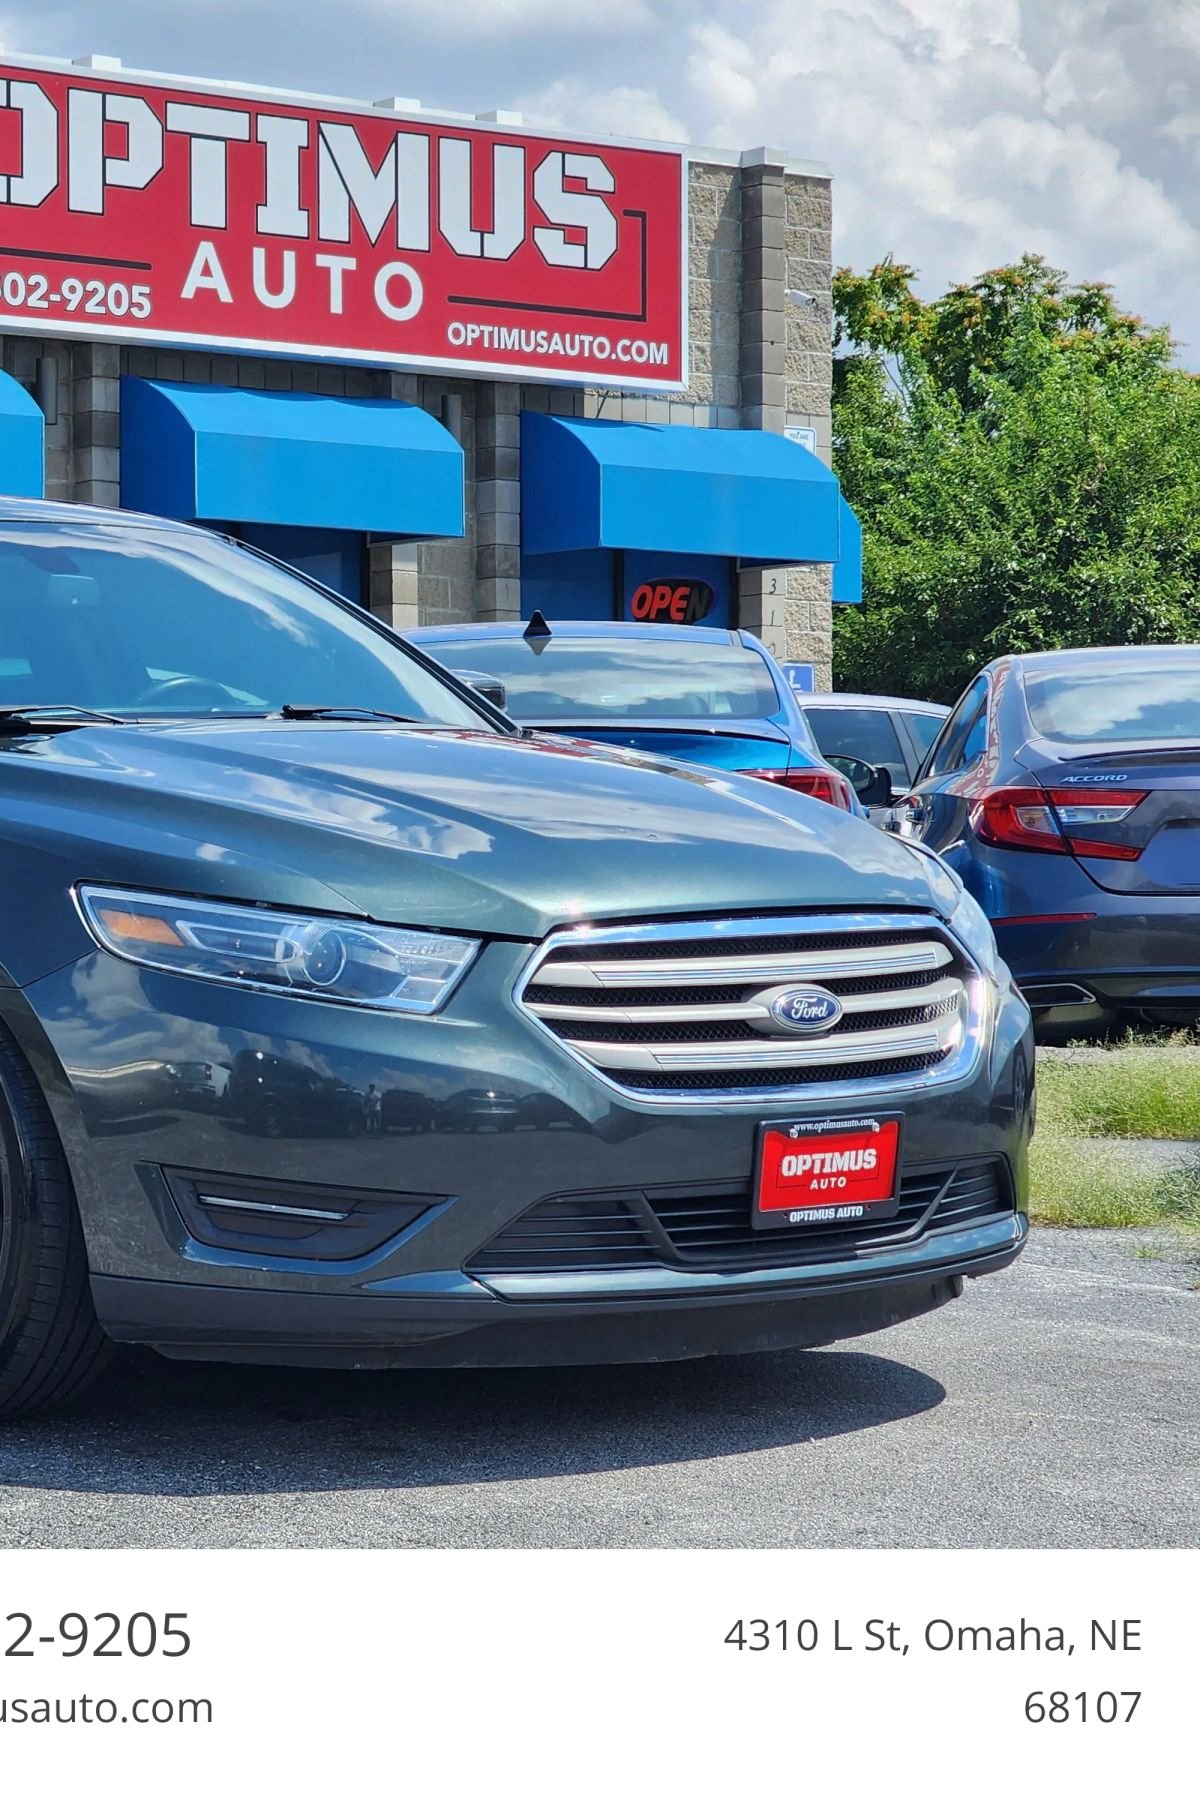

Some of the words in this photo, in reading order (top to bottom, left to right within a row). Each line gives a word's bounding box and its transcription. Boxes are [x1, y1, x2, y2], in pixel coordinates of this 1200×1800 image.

[180, 241, 425, 322] AUTO
[446, 321, 669, 366] OPTIMUSAUTO.COM
[631, 584, 709, 621] OPEN
[1060, 774, 1128, 783] ACCORD
[791, 997, 828, 1020] Ford
[793, 1117, 876, 1134] www.optimusauto.com
[781, 1148, 877, 1178] OPTIMUS
[810, 1176, 847, 1190] AUTO
[789, 1207, 835, 1223] OPTIMUS
[837, 1205, 863, 1218] AUTO
